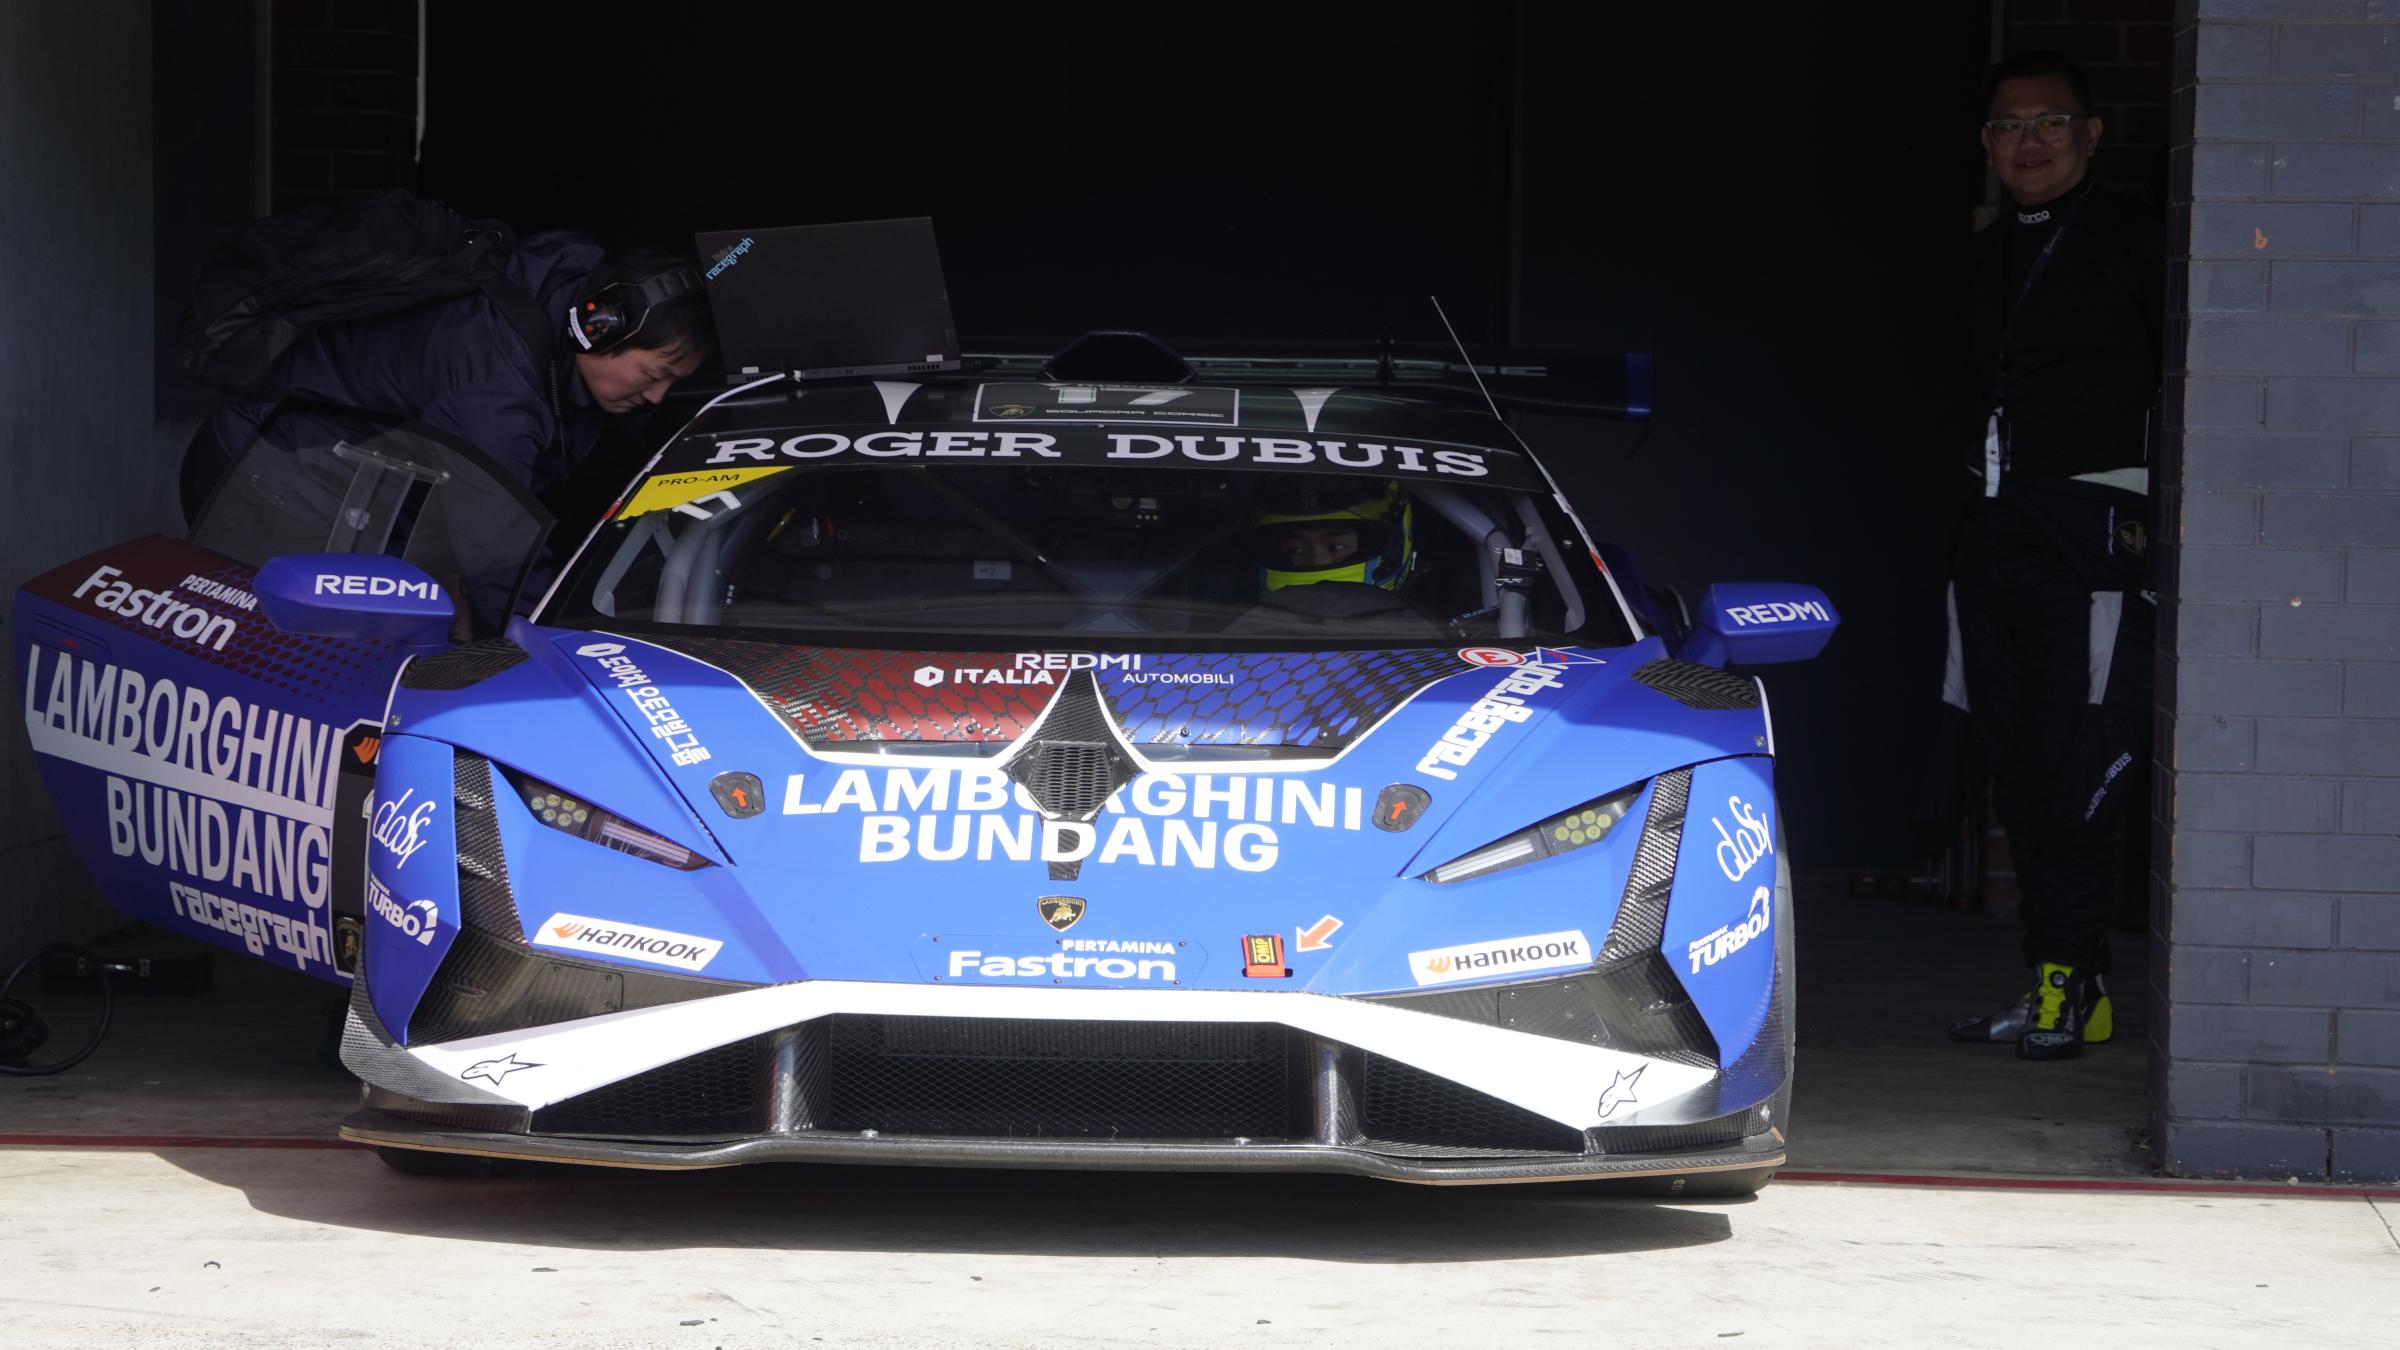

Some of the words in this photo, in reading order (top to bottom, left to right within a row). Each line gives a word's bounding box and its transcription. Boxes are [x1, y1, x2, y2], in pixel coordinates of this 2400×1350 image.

[705, 237, 755, 280] racegraph
[705, 431, 1062, 464] ROGER
[1106, 433, 1490, 477] DUBUIS
[657, 473, 740, 488] PRO-AM
[73, 565, 237, 651] Fastron
[179, 574, 258, 612] PERTAMINA
[314, 574, 438, 600] REDMI
[1726, 601, 1830, 626] REDMI
[954, 667, 1054, 685] ITALIA
[1122, 673, 1234, 685] AUTOMOBILI
[1015, 653, 1141, 671] REDMI
[25, 643, 345, 810] LAMBORGHINI
[1415, 660, 1569, 781] racegraph
[782, 768, 1362, 830] LAMBGHINI
[107, 774, 329, 909] BUNDANG
[859, 814, 1279, 873] BUNDANG
[170, 880, 332, 970] racegraph
[367, 881, 421, 937] TURBO
[949, 951, 1176, 981] Fastron
[1062, 939, 1176, 955] PERTAMINA
[1255, 938, 1272, 963] OMP
[1688, 914, 1762, 975] TURBO
